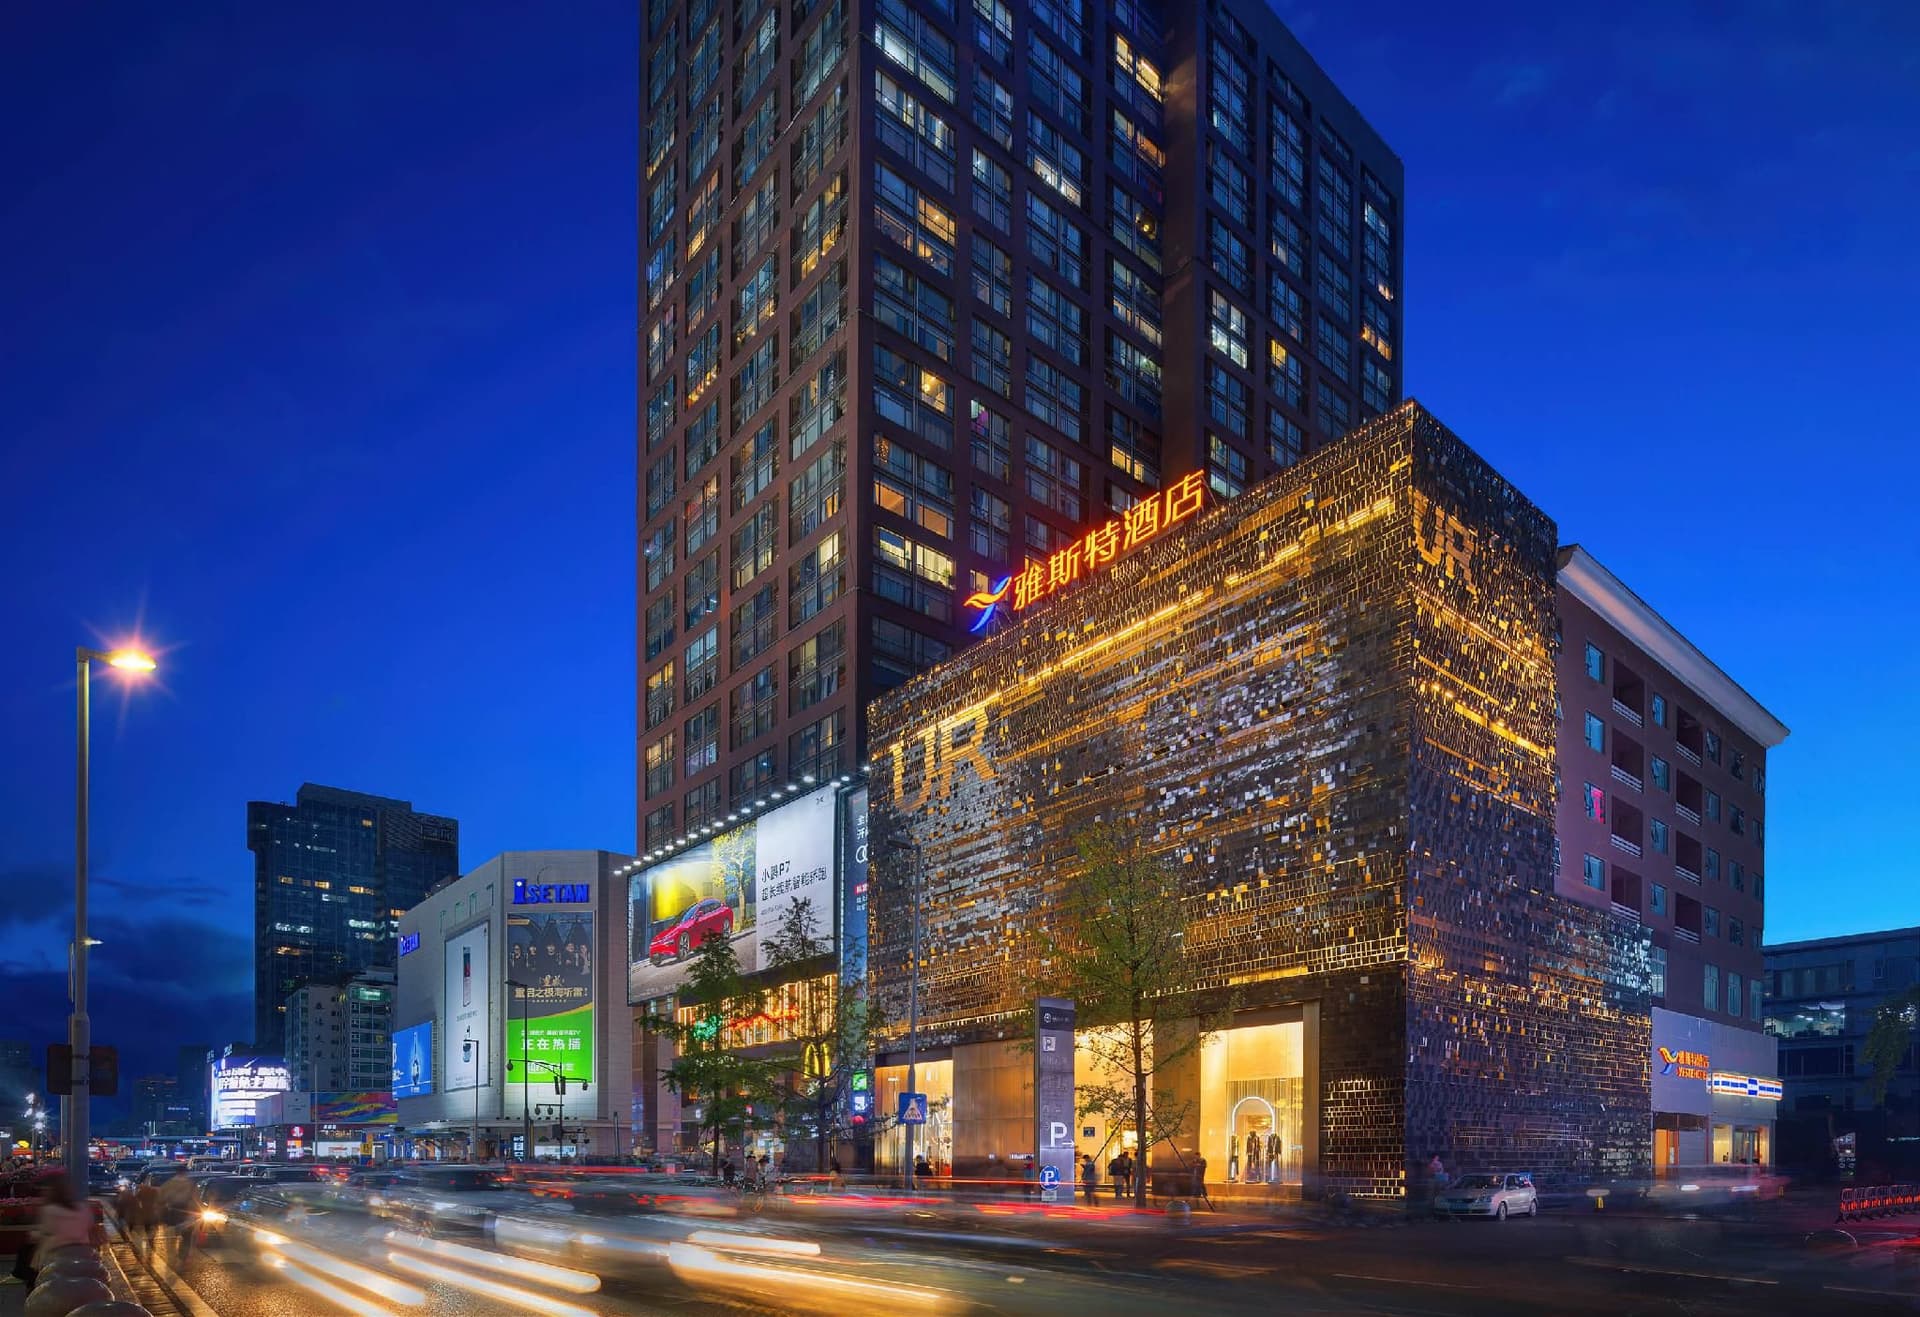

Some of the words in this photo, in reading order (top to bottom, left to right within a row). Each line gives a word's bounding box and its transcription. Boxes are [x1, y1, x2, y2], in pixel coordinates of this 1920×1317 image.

[1014, 469, 1204, 611] 雅斯特酒店
[1408, 486, 1478, 596] UR
[889, 705, 999, 813] UR
[1044, 1170, 1055, 1186] P
[1051, 1121, 1068, 1148] P
